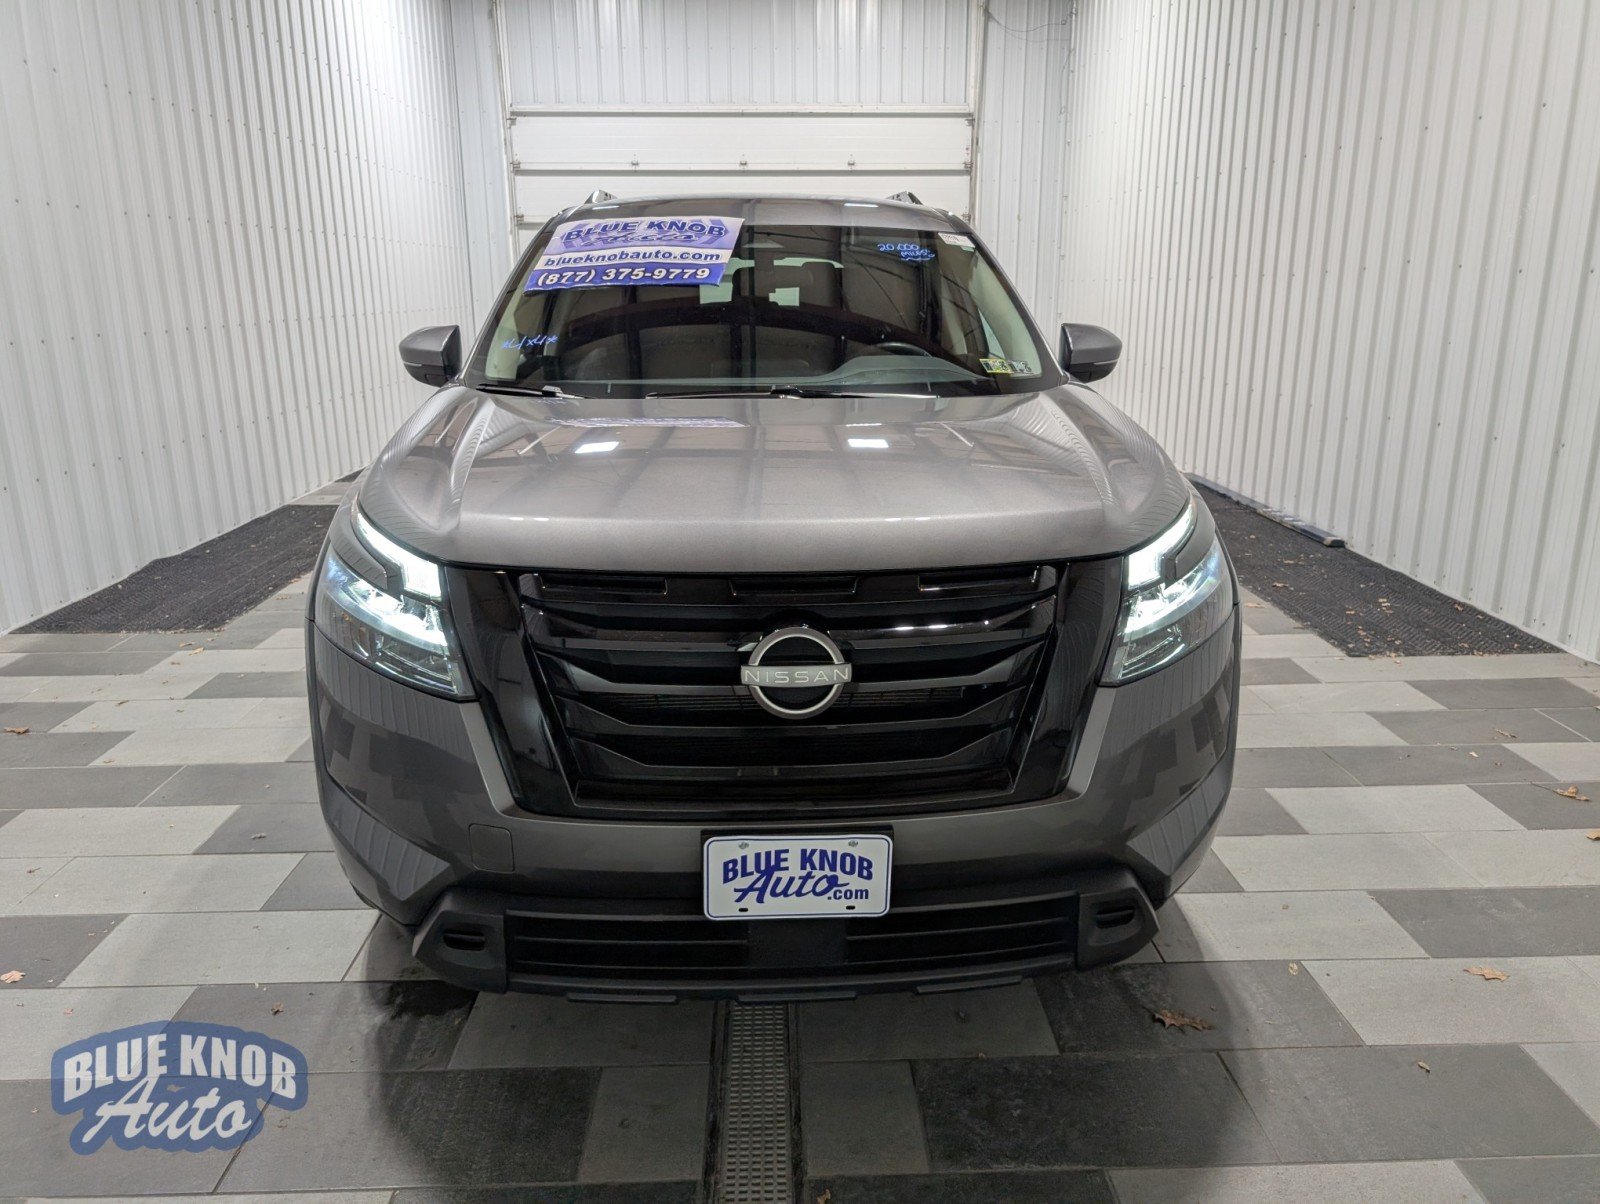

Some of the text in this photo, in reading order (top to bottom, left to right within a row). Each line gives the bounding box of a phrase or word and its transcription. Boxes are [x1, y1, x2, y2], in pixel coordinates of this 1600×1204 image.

[563, 219, 726, 242] BLUE KNOB
[544, 250, 721, 267] blueknobauto.com
[537, 267, 711, 287] (877) 375-9779
[744, 667, 849, 684] NISSAN
[722, 848, 873, 884] BLUE KNOB
